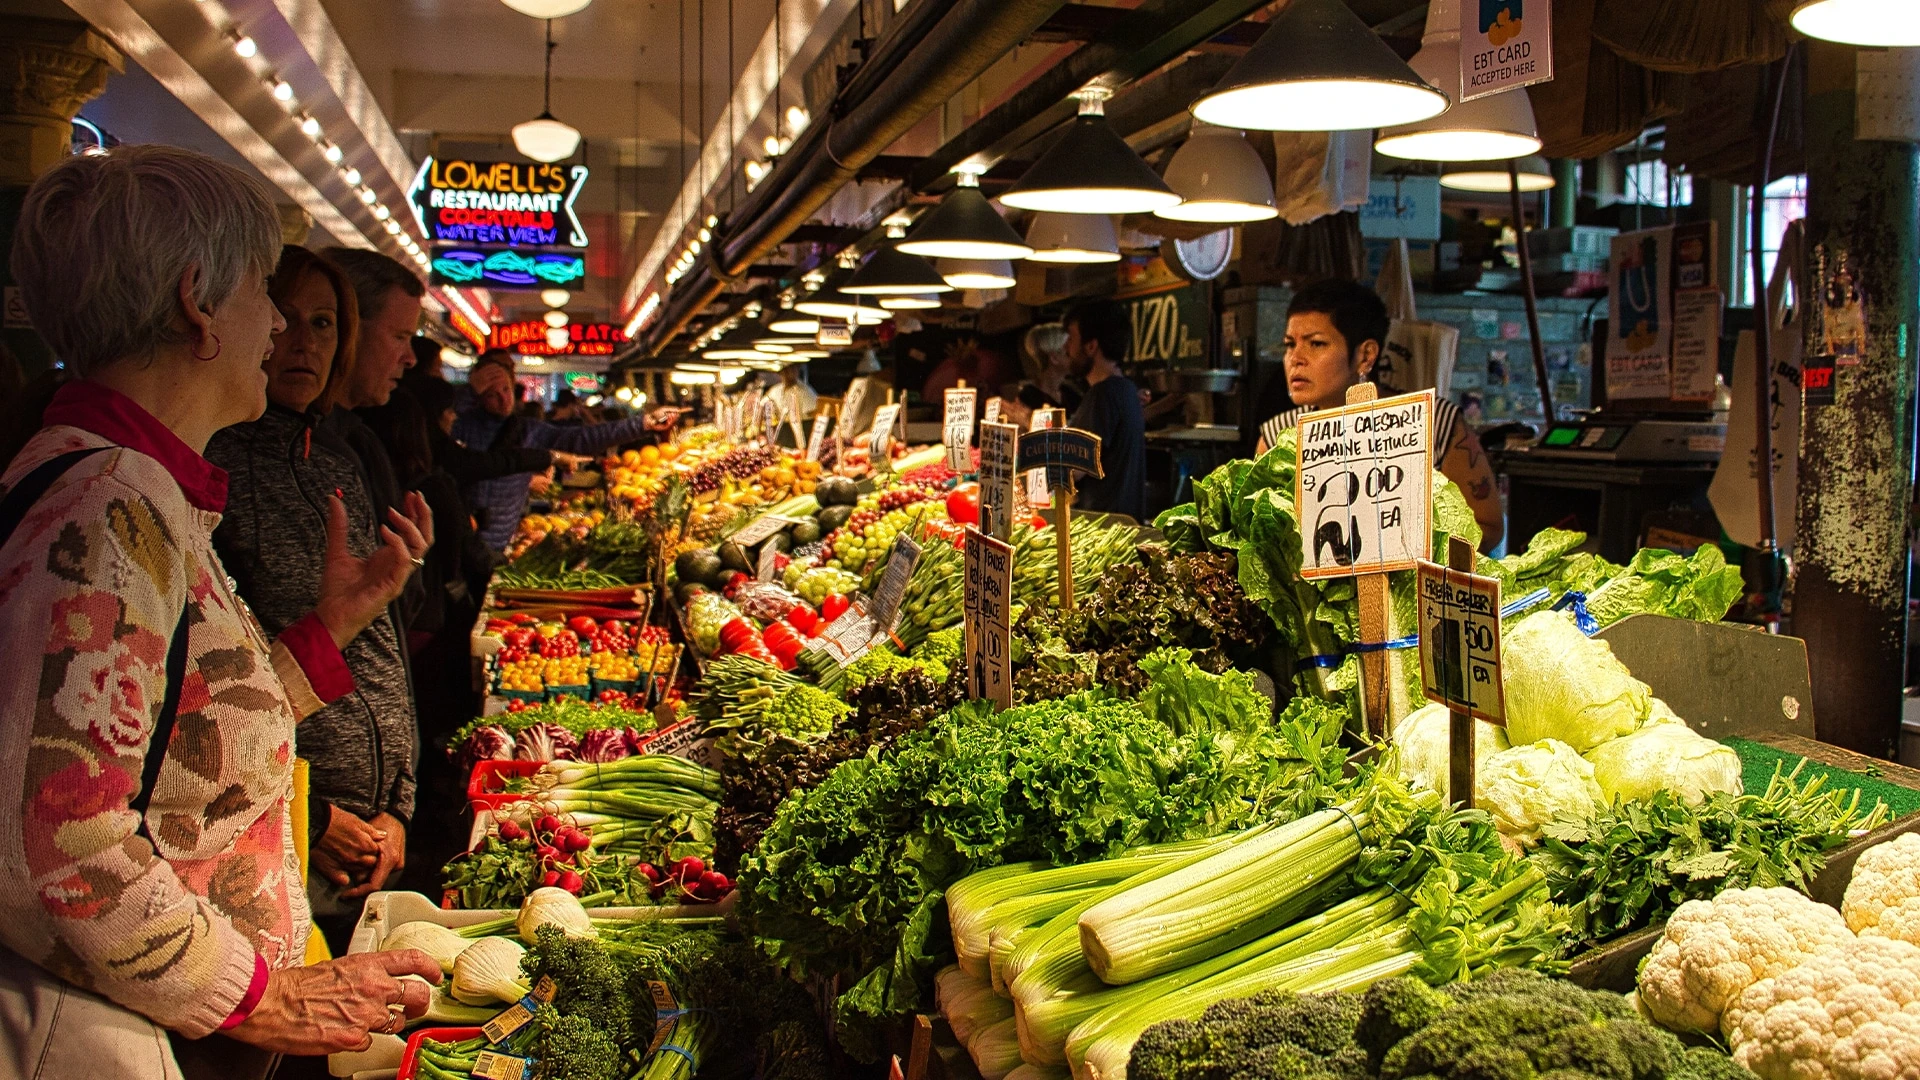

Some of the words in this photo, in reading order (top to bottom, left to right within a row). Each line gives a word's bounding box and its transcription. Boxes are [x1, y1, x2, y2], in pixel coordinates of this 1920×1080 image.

[1474, 50, 1495, 71] EBT
[1498, 42, 1531, 64] CARD
[1471, 67, 1512, 88] ACCEPTED
[1514, 60, 1536, 77] HERE
[430, 159, 567, 193] LOWELL'S
[430, 189, 563, 213] RESTAURANT
[440, 207, 555, 230] COCKTAILS
[435, 223, 506, 242] WATER
[508, 227, 558, 245] VIEW
[566, 324, 611, 341] EAT
[1308, 420, 1346, 443] HAIL
[1354, 405, 1423, 434] CAESAR!!
[1302, 438, 1361, 464] ROMAINE
[1368, 432, 1419, 454] LETTUCE
[1380, 505, 1402, 530] EA
[984, 547, 1006, 573] TENDER
[1425, 577, 1454, 602] FRESH
[1463, 620, 1494, 652] 50
[1472, 665, 1491, 685] EA
